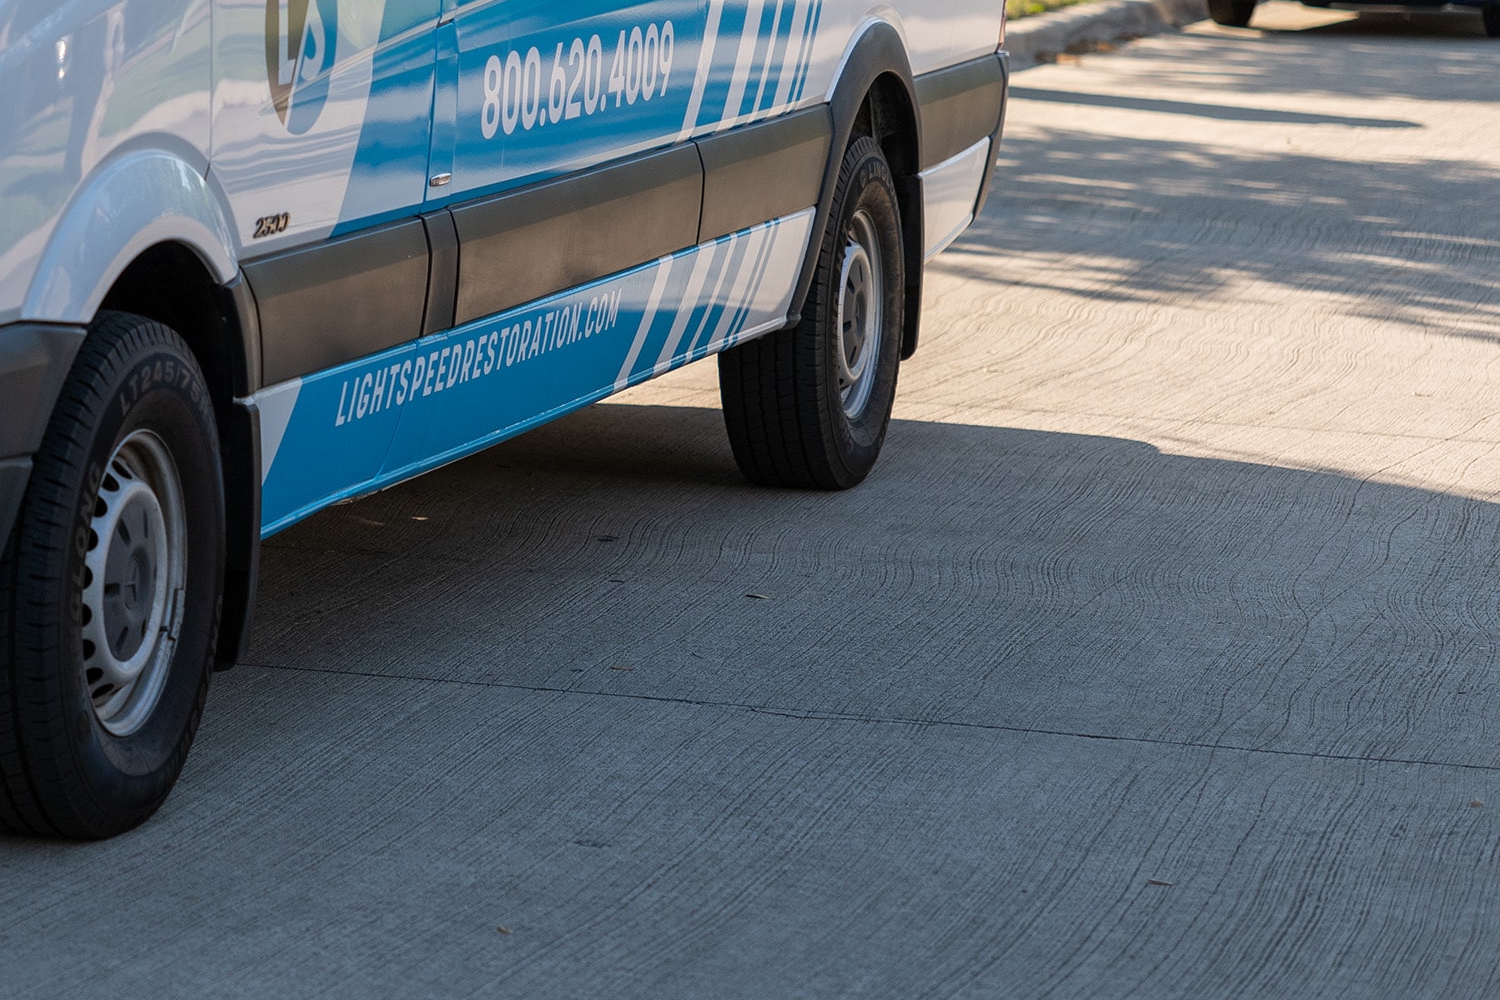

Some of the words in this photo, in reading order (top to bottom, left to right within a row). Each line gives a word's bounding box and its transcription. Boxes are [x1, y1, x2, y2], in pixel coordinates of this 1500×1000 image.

[480, 20, 676, 140] 800.620.4009
[252, 211, 291, 239] 2500
[334, 288, 623, 427] LIGHTSPEEDRESTORATION.COM
